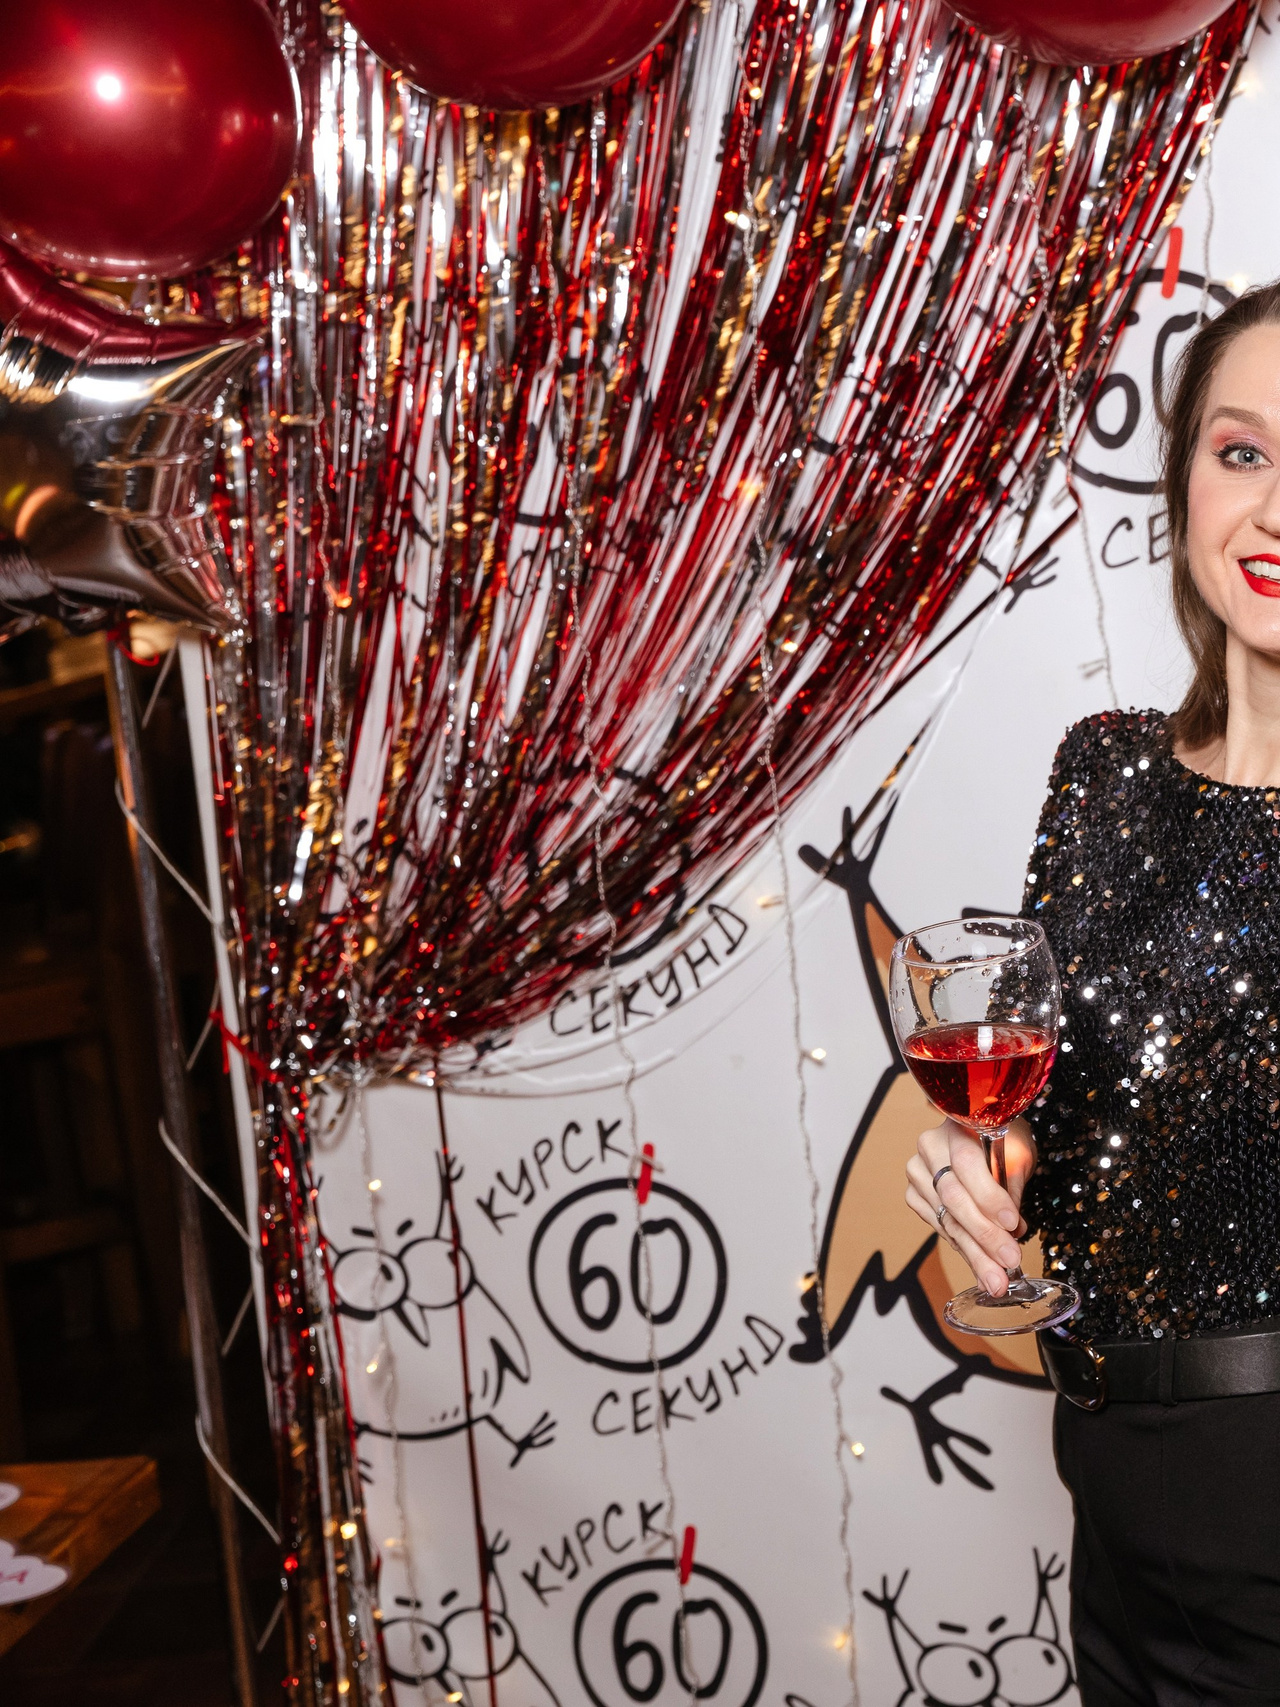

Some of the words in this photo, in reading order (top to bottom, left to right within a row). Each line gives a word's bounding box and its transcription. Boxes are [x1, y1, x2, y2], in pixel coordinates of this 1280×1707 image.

[476, 1119, 630, 1234] КУРСК
[568, 1211, 692, 1332] 60
[521, 1500, 669, 1607] КУРСК
[613, 1592, 733, 1704] 60
